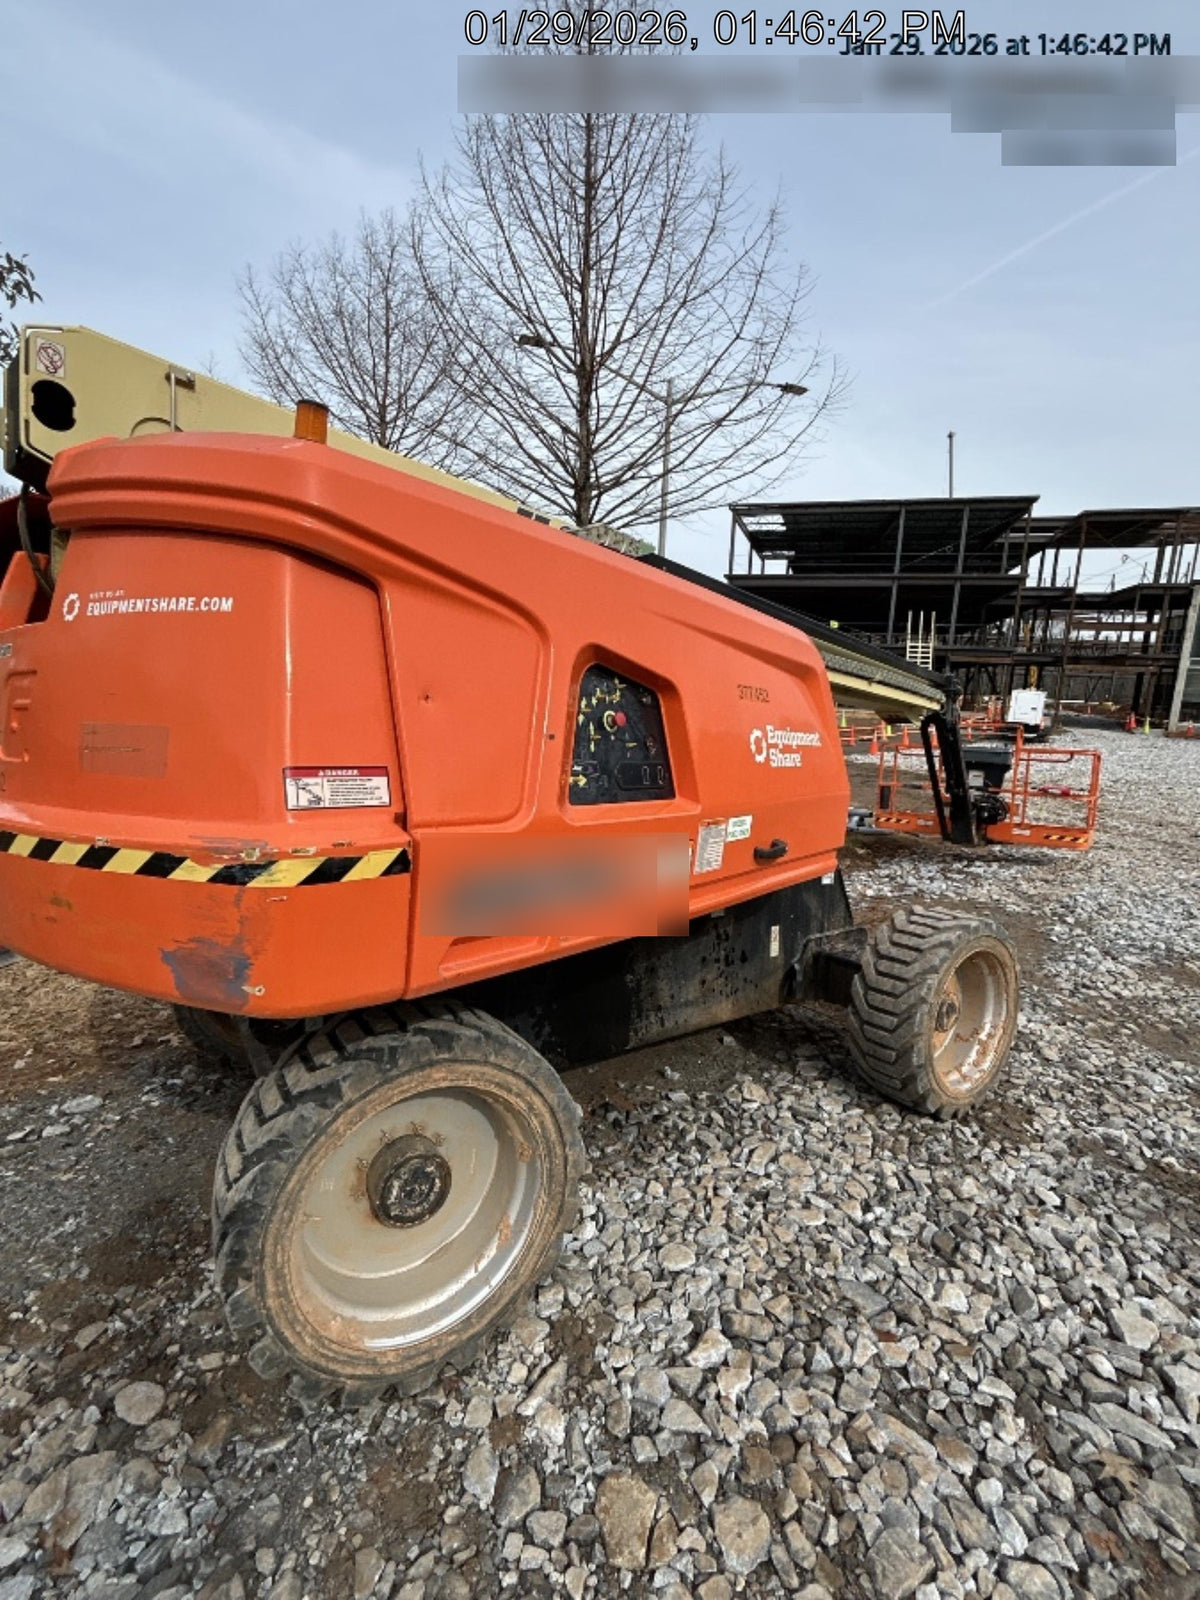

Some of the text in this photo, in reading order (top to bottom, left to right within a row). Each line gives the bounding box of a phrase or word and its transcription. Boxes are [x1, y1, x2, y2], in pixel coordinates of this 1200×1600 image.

[86, 597, 233, 616] EQUIPMENTSHARE.COM
[765, 724, 822, 750] Equipment
[769, 748, 802, 768] Share
